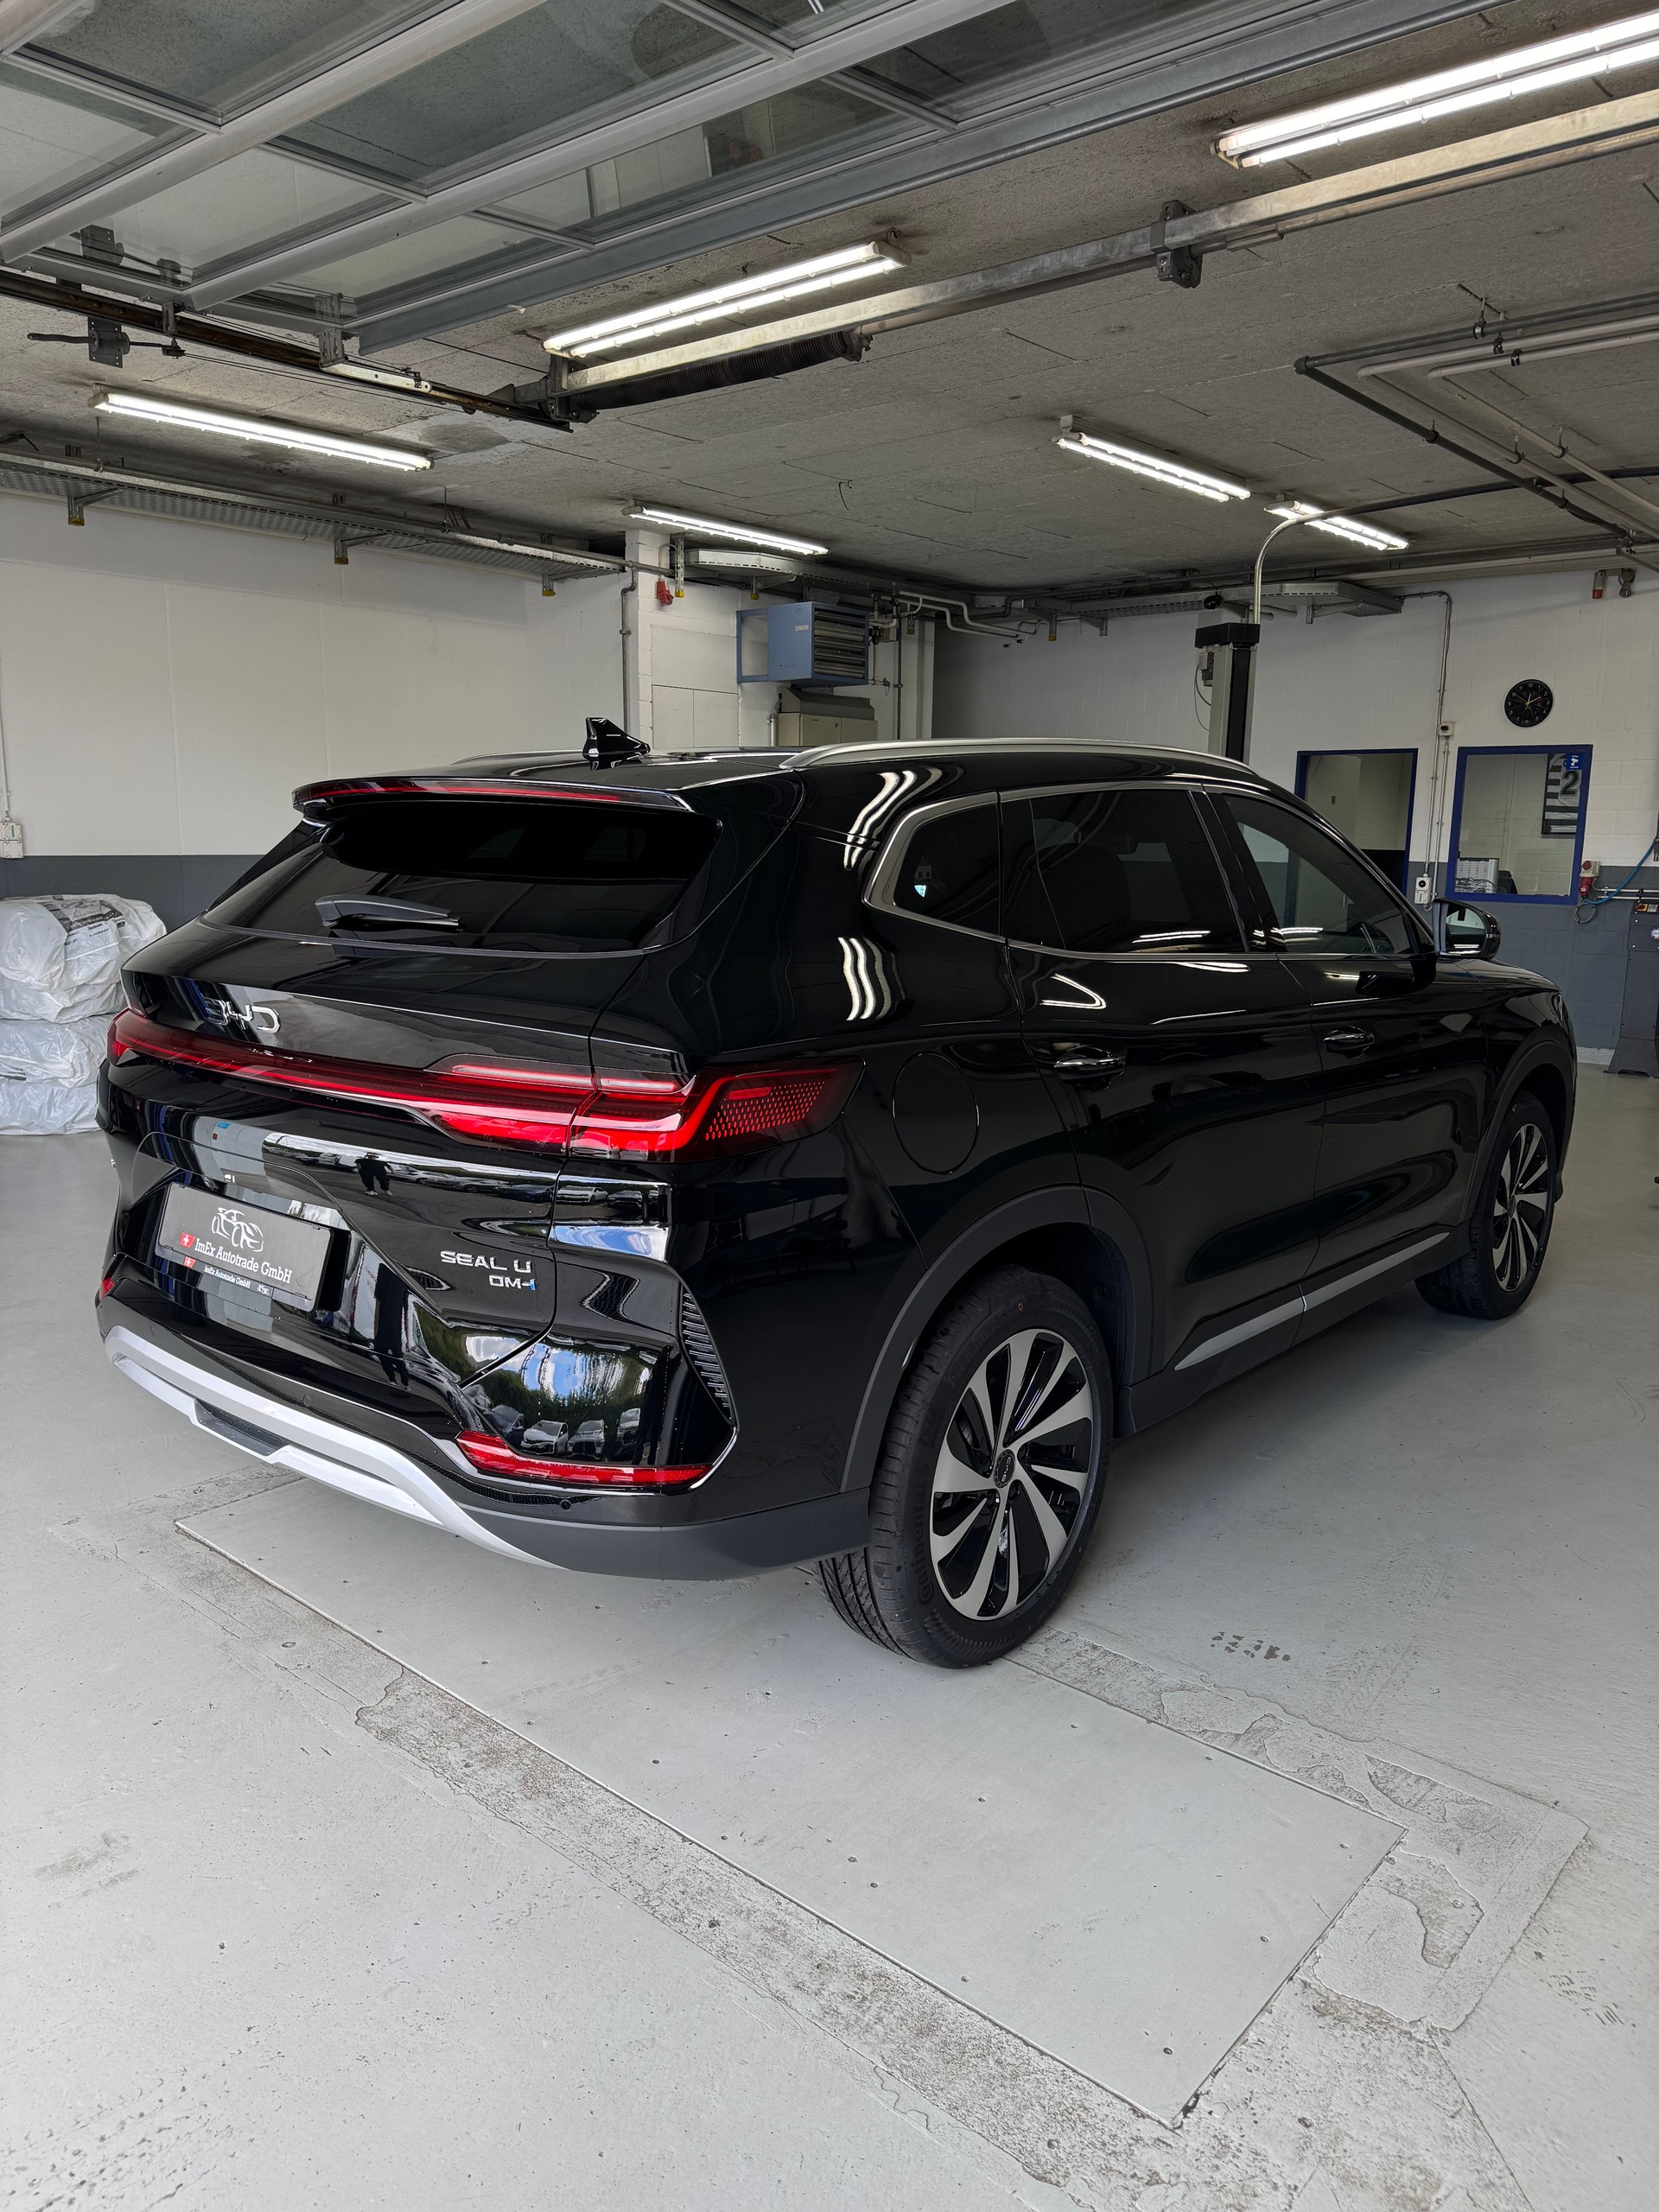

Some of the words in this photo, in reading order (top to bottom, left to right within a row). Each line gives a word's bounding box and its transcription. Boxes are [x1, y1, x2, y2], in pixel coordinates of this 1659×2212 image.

[1560, 769, 1580, 798] 2
[204, 997, 281, 1034] BYD
[194, 1238, 216, 1256] ImEx
[215, 1246, 259, 1273] Autotrade
[261, 1262, 293, 1284] GmbH
[440, 1249, 508, 1271] SEAL
[513, 1259, 532, 1274] U
[215, 1269, 236, 1283] Autotrade
[236, 1277, 251, 1288] GmbH
[912, 1484, 935, 1605] Continental
